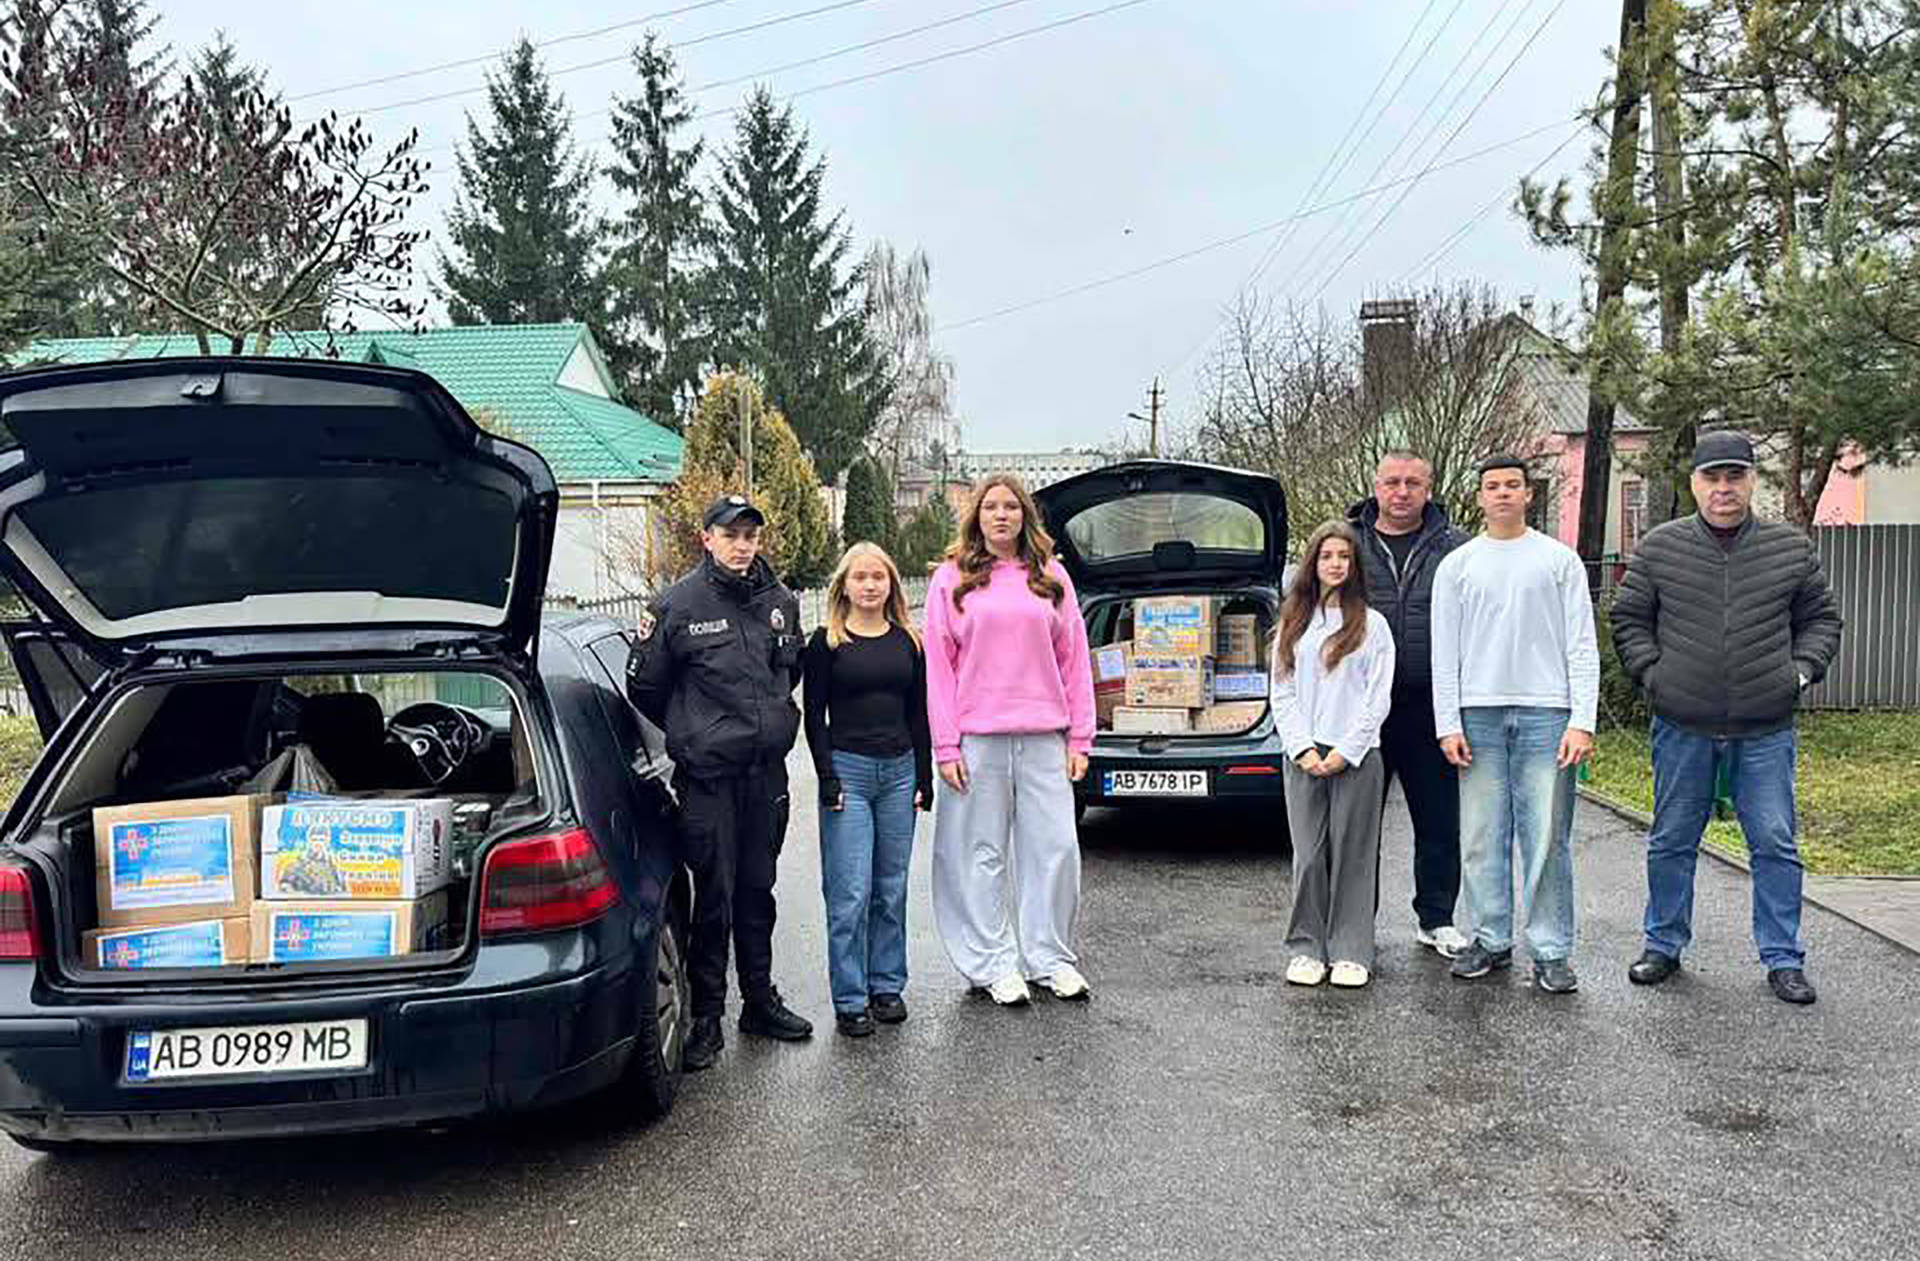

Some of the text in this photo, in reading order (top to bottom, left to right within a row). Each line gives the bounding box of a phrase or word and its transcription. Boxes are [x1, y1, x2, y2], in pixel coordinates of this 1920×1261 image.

[1114, 773, 1203, 790] AB 7678 IP
[153, 1026, 352, 1071] AB 0989 MB
[132, 1058, 148, 1070] UA
